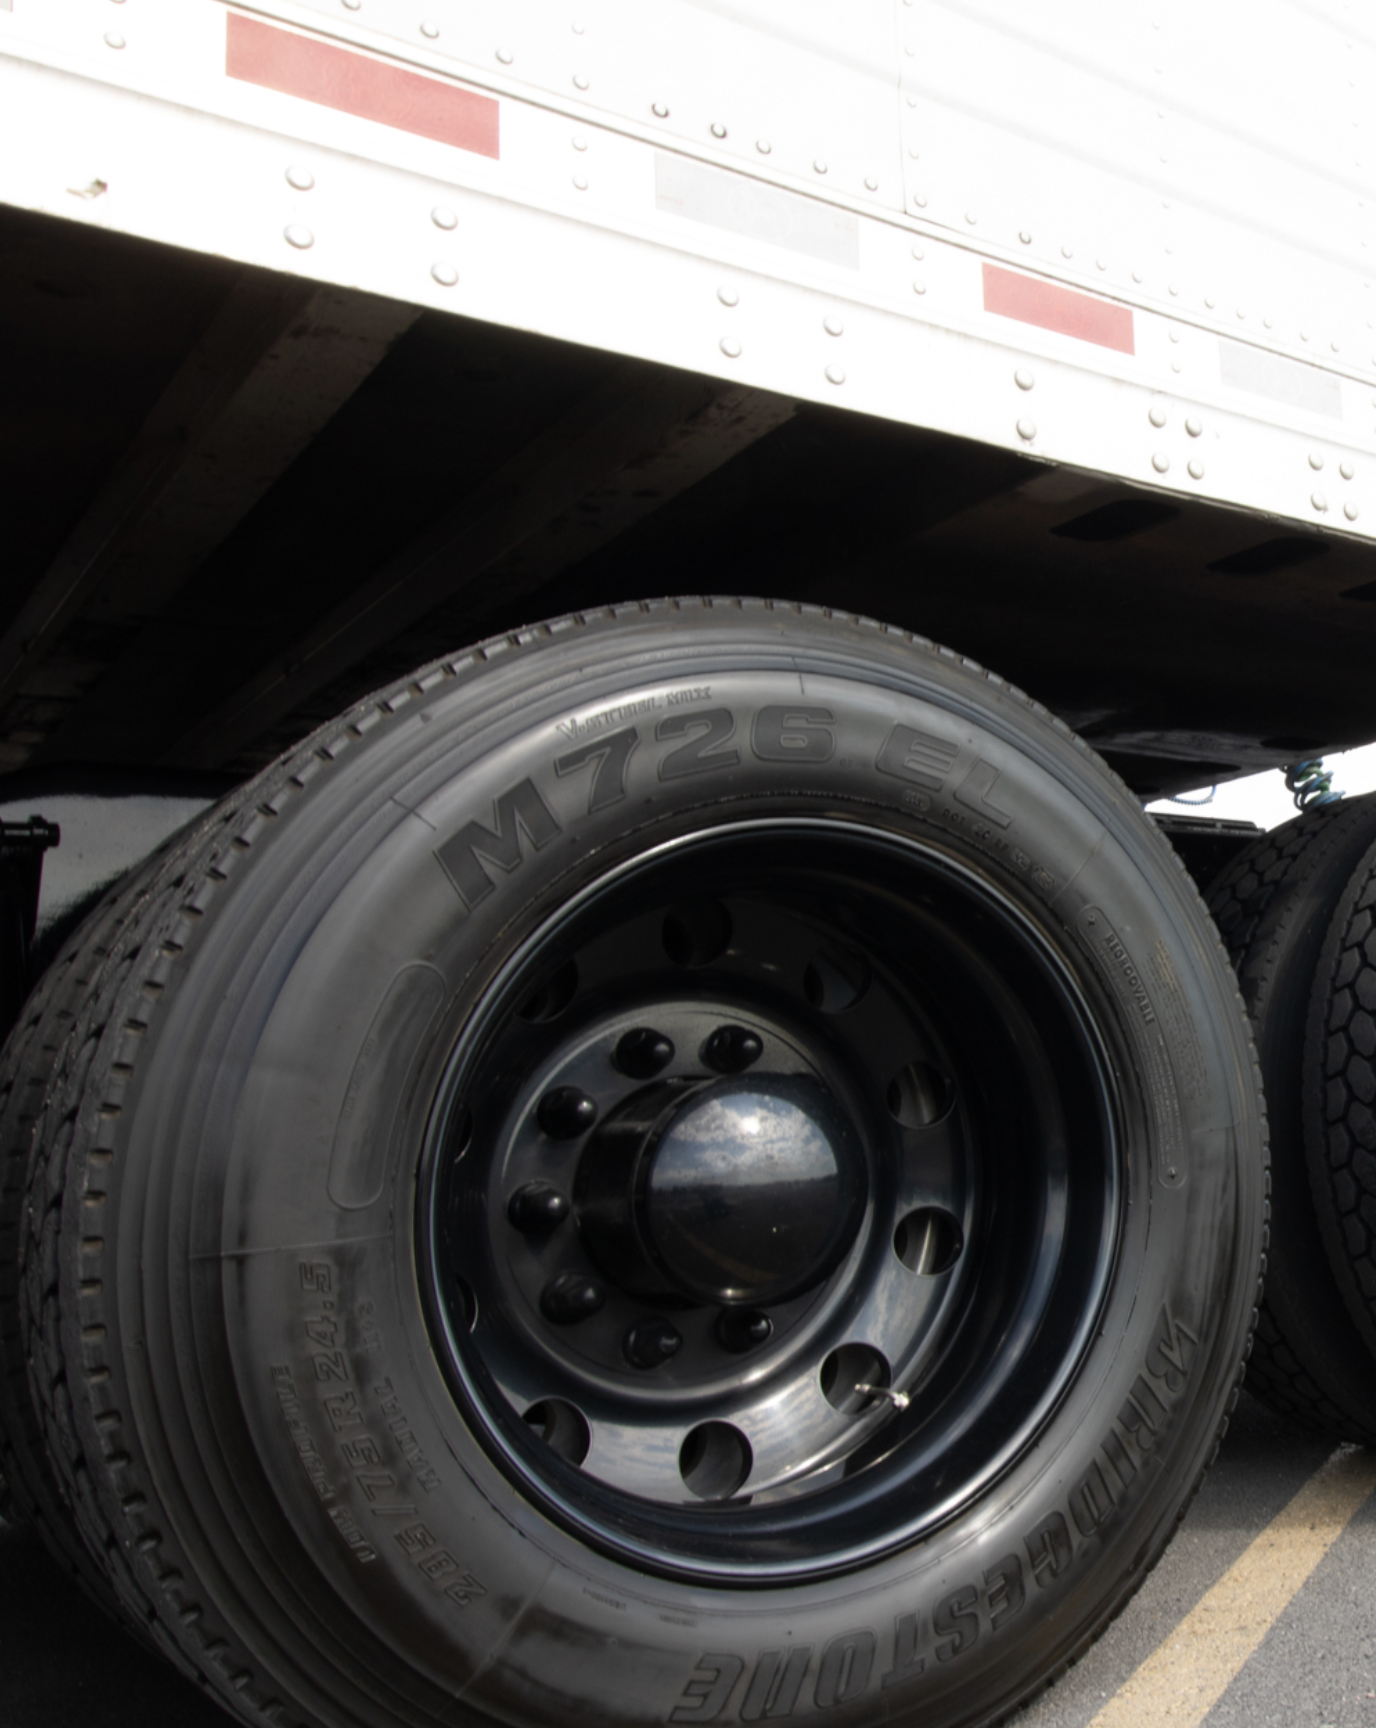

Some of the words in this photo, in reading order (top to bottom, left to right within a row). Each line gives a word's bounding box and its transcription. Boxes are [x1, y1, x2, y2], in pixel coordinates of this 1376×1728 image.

[433, 706, 839, 912] M726
[876, 723, 1013, 829] EL
[268, 1363, 335, 1498] PROFILE
[672, 1304, 1197, 1722] BRIDGESTONE
